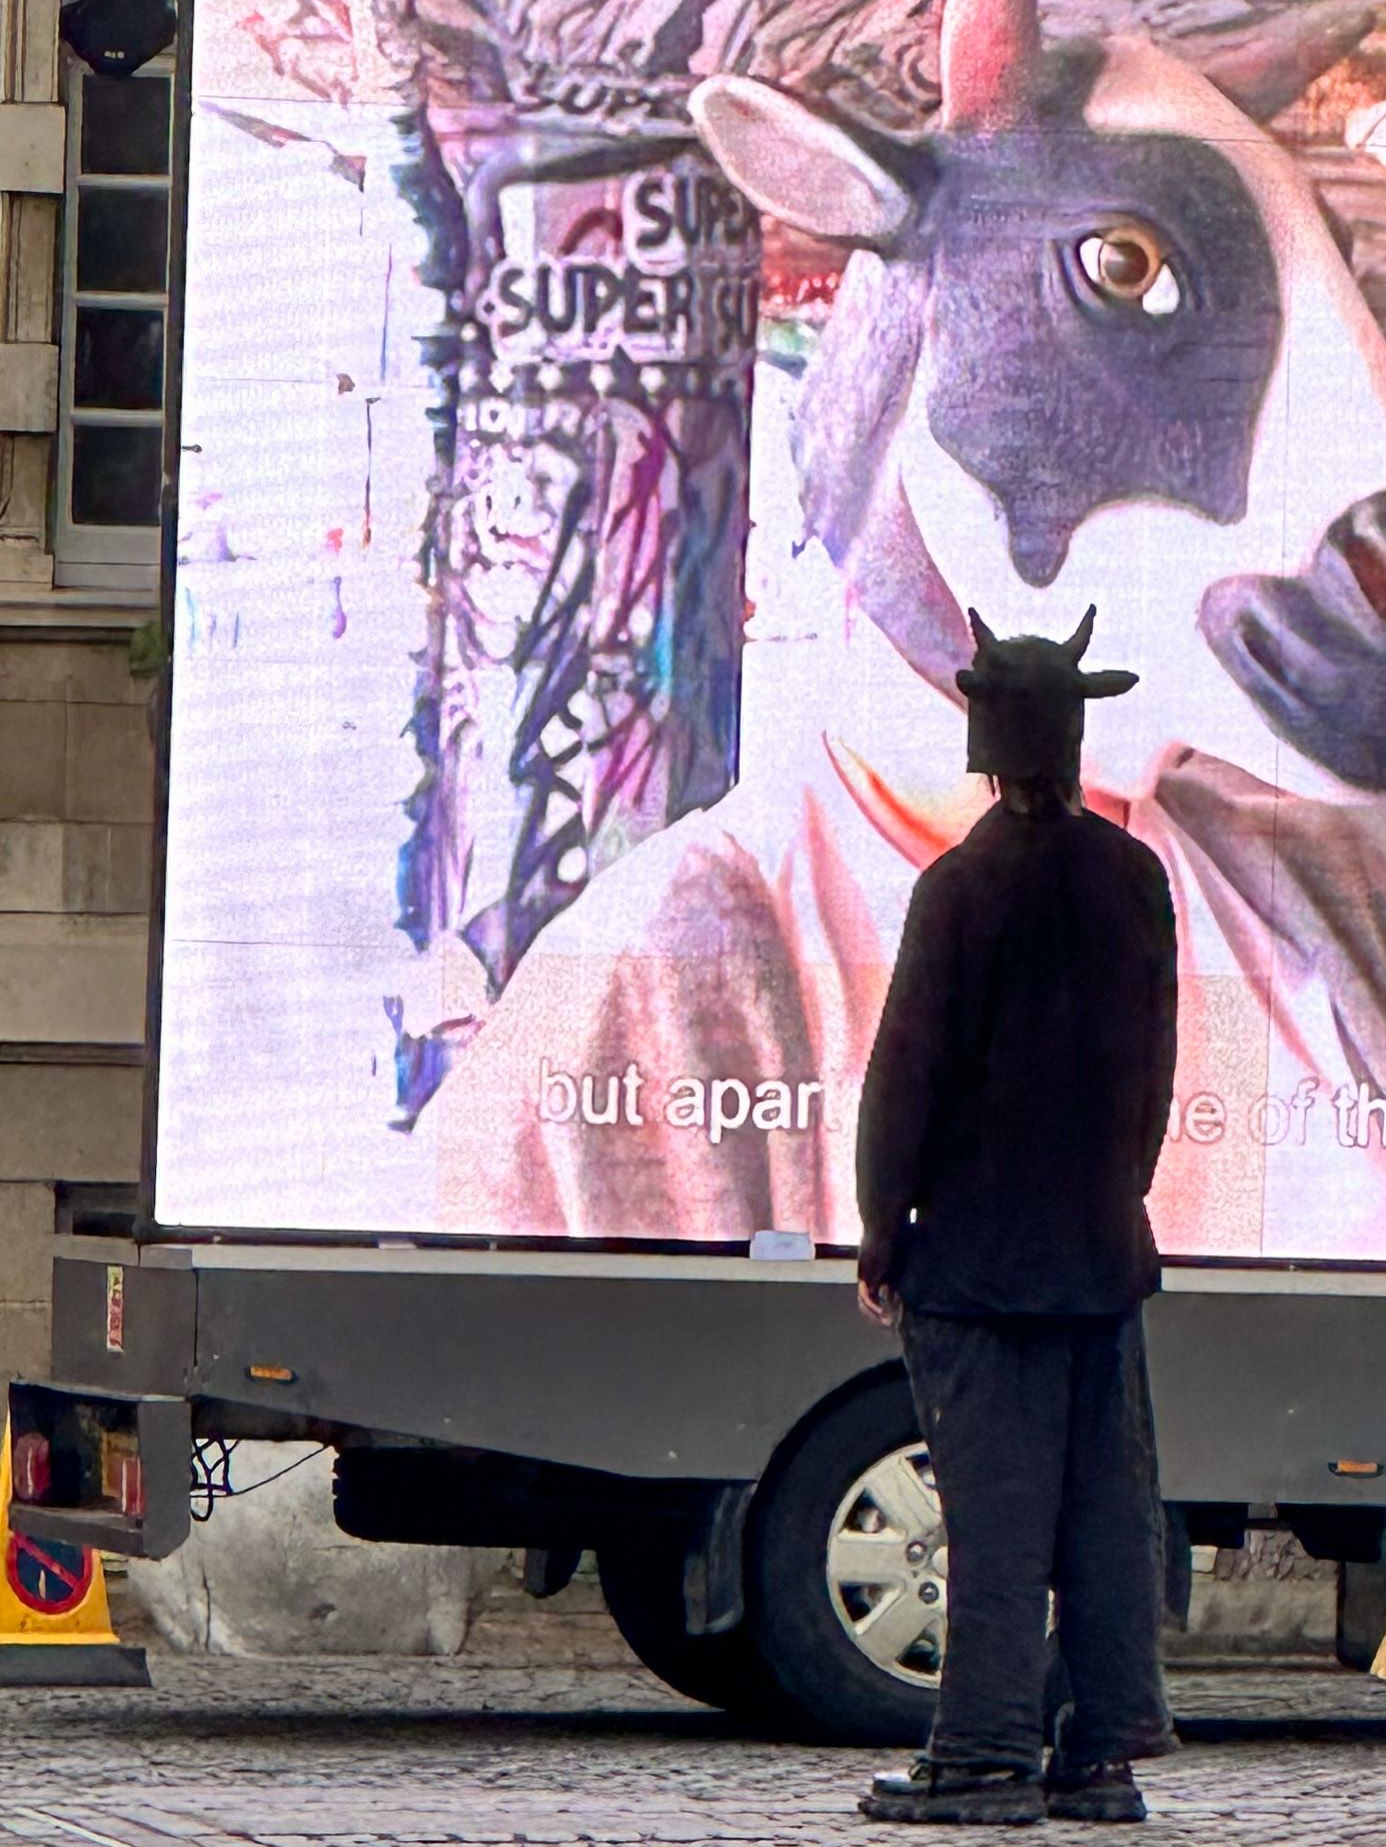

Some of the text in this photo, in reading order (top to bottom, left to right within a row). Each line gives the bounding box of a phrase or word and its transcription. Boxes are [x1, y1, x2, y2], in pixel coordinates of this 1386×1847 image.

[498, 264, 695, 335] SUPER
[539, 1056, 645, 1126] but
[1248, 1075, 1319, 1146] of
